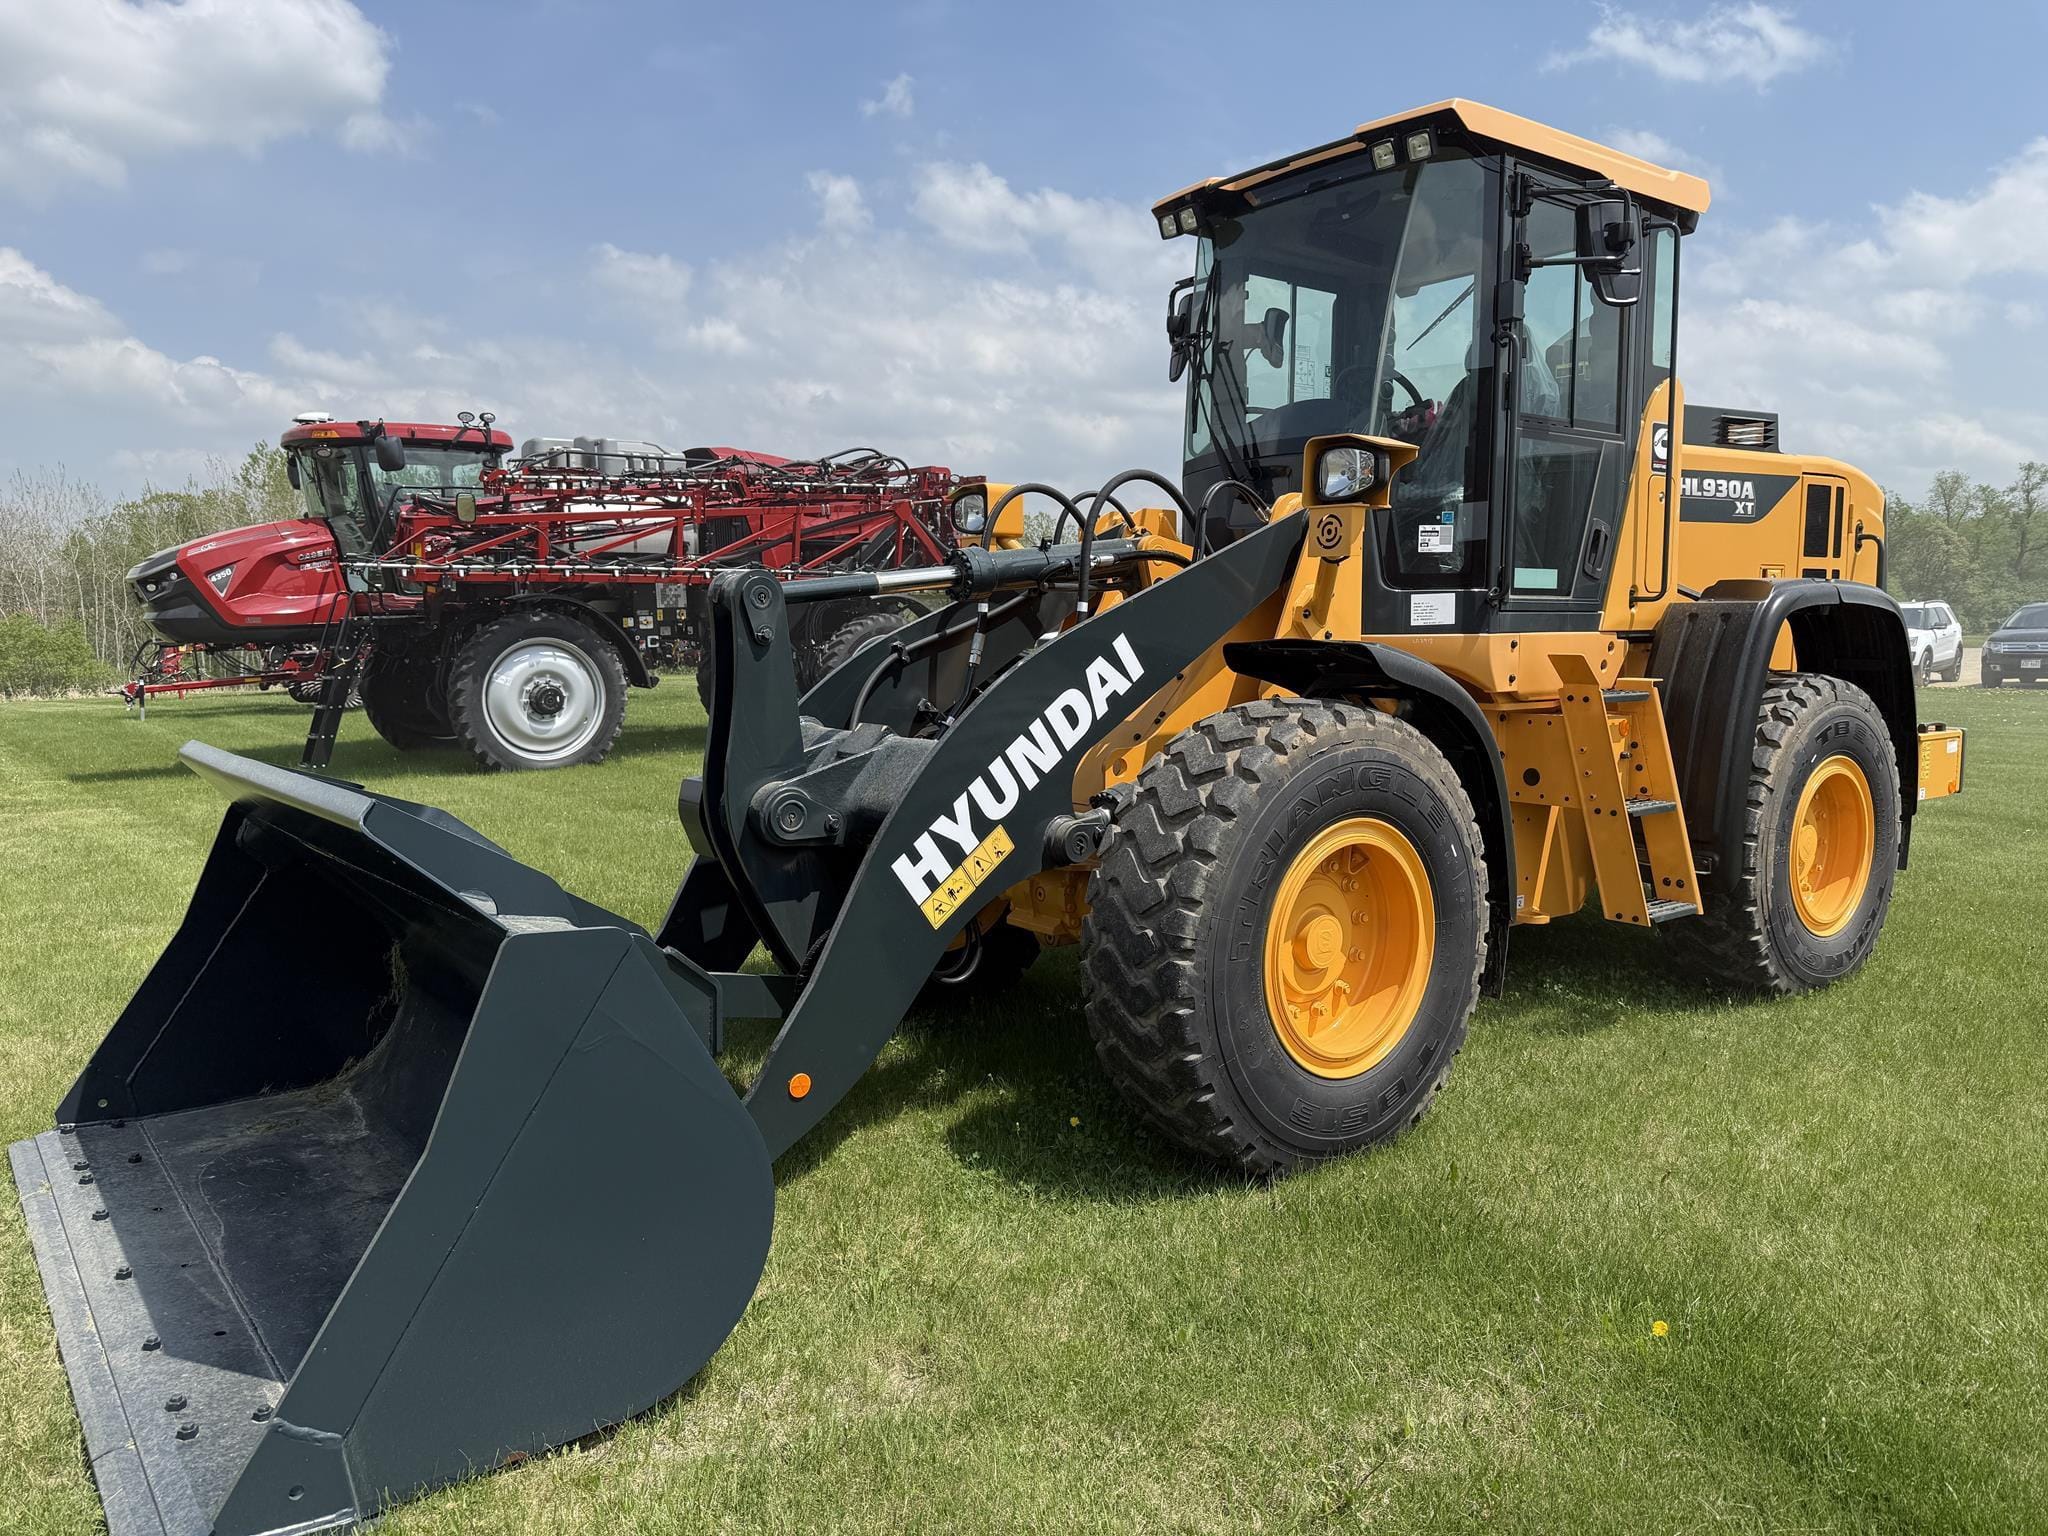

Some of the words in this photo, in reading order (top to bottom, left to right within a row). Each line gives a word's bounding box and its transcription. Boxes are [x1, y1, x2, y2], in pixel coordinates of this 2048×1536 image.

[1680, 477, 1755, 499] HL930A
[1735, 501, 1755, 515] XT
[297, 550, 324, 561] CASE
[211, 568, 232, 582] 4350
[891, 632, 1145, 906] HYUNDAI
[1229, 766, 1449, 962] TRIANGLE
